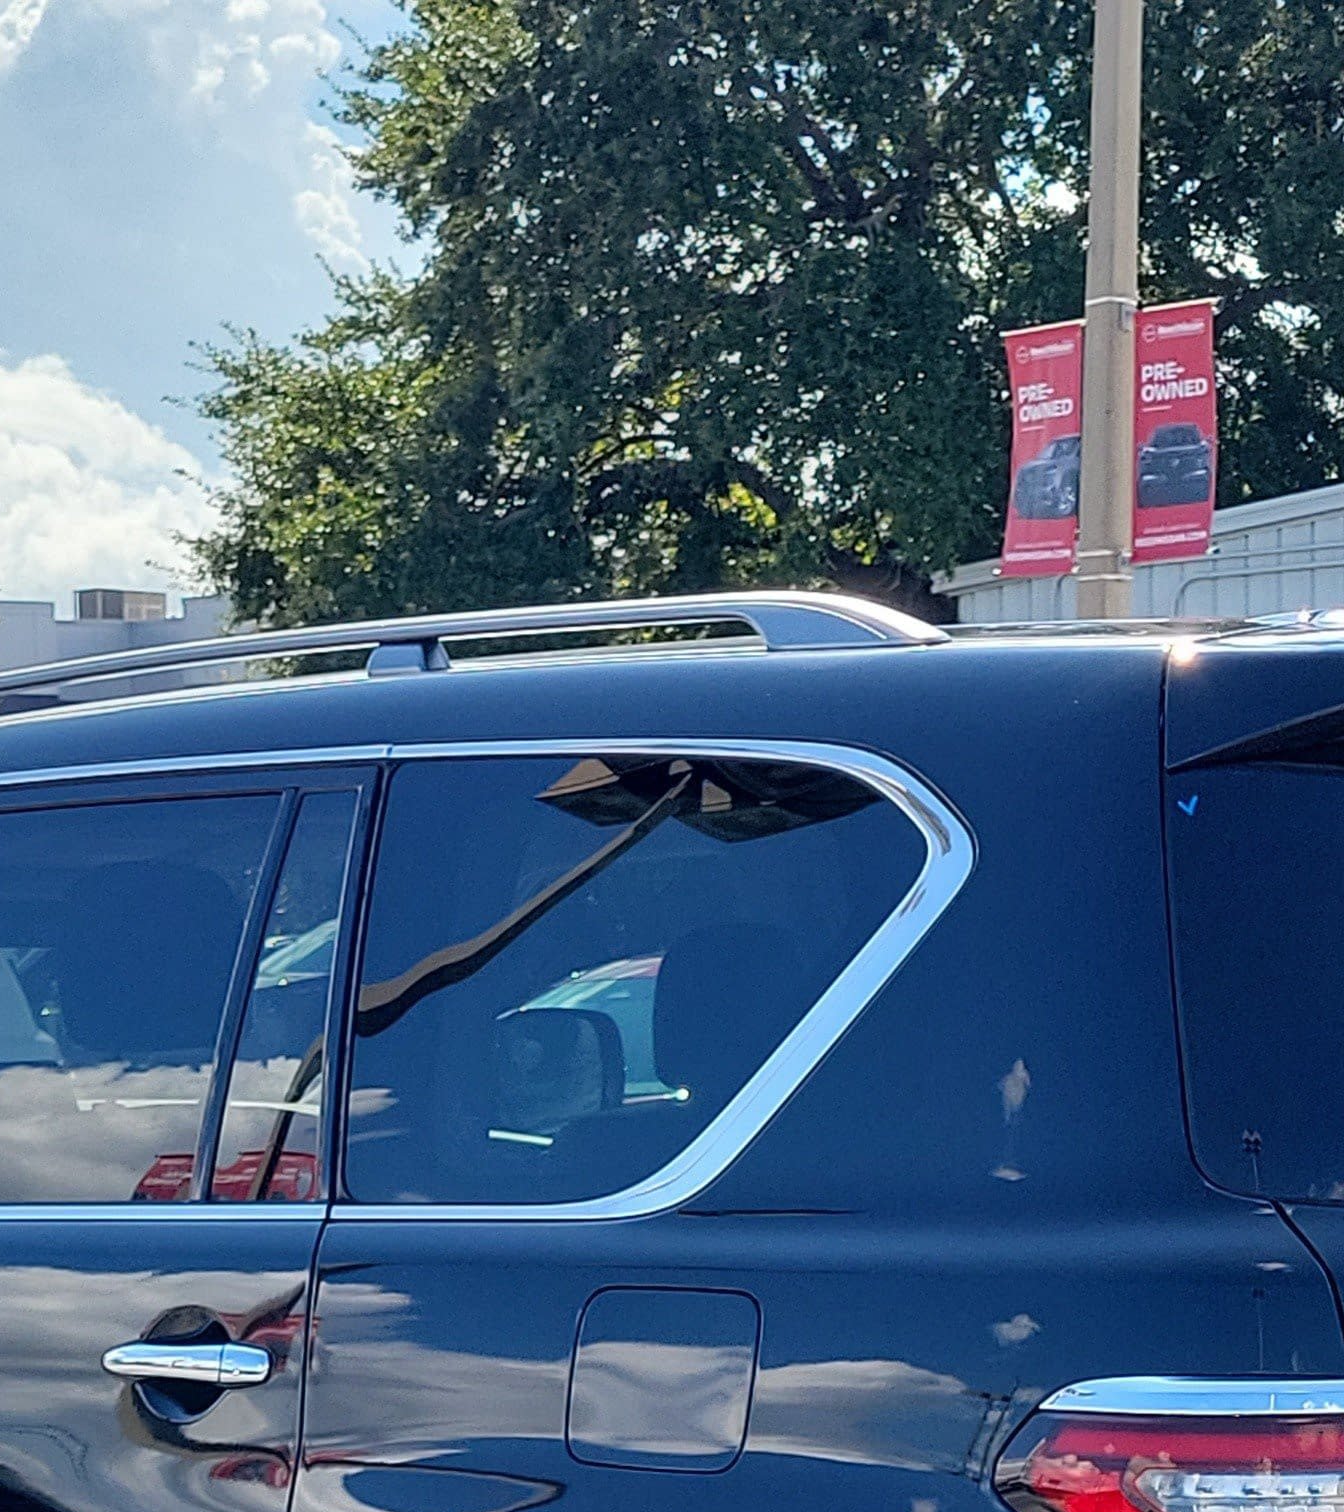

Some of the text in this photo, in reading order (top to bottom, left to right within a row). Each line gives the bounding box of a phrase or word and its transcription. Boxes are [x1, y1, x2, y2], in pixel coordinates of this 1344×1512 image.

[1140, 361, 1185, 383] PRE-
[1018, 383, 1054, 404] PRE-
[1141, 378, 1208, 402] OWNED
[1019, 398, 1074, 422] OWNED
